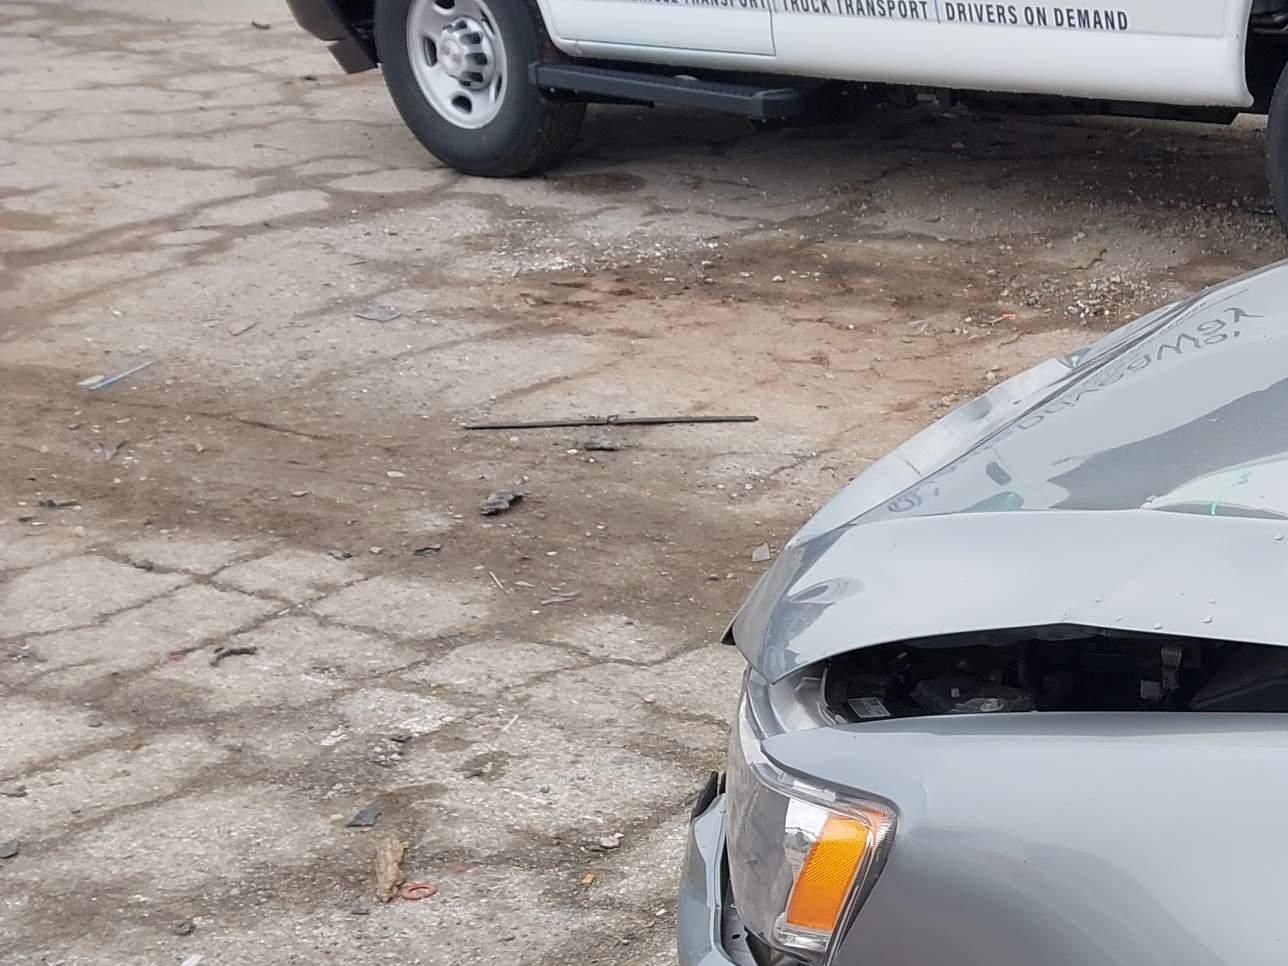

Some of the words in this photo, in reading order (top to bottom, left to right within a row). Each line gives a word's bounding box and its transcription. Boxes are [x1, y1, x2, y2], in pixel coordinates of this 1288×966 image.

[783, 0, 831, 14] TRUCK
[837, 0, 929, 19] TRANSPORT
[945, 2, 1018, 24] DRIVERS
[1024, 6, 1048, 27] ON
[1054, 7, 1129, 31] DEMAND
